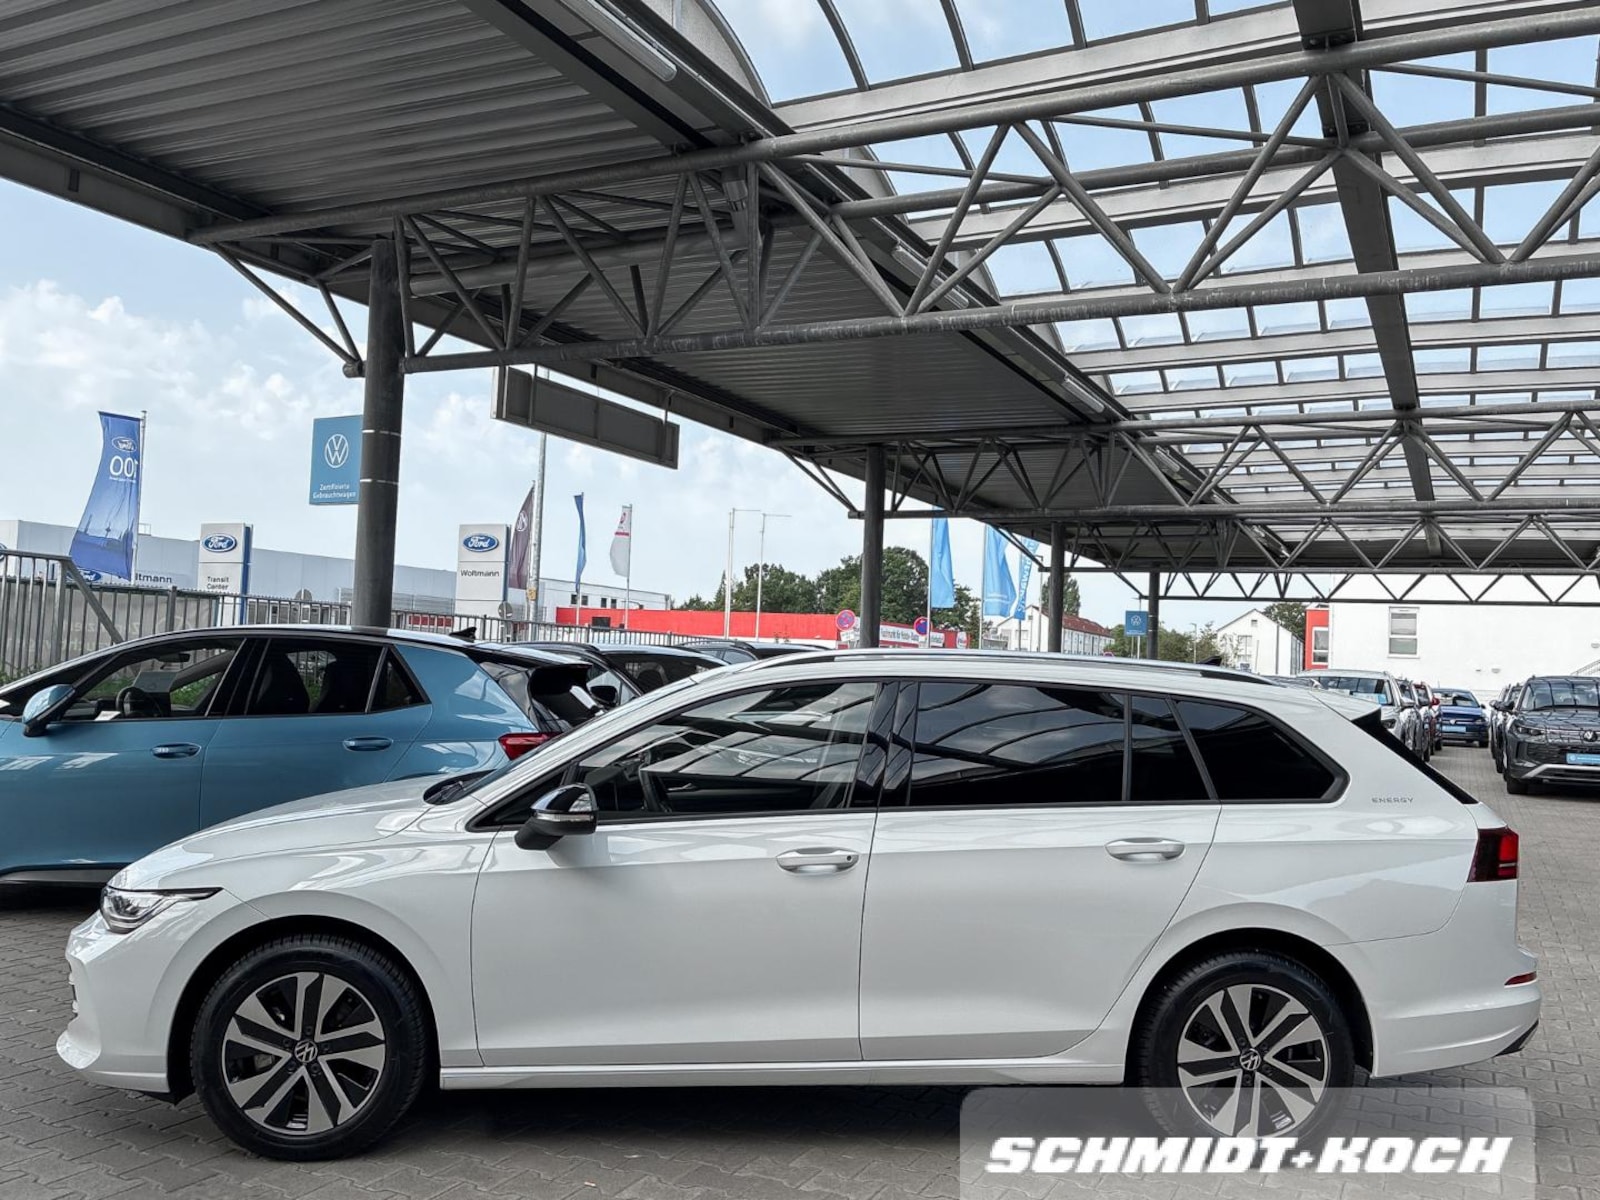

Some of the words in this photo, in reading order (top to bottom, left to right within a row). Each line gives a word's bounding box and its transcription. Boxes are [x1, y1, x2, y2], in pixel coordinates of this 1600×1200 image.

[460, 569, 499, 577] Woltmann
[135, 572, 173, 584] ltmann
[1371, 796, 1414, 804] ENERGY
